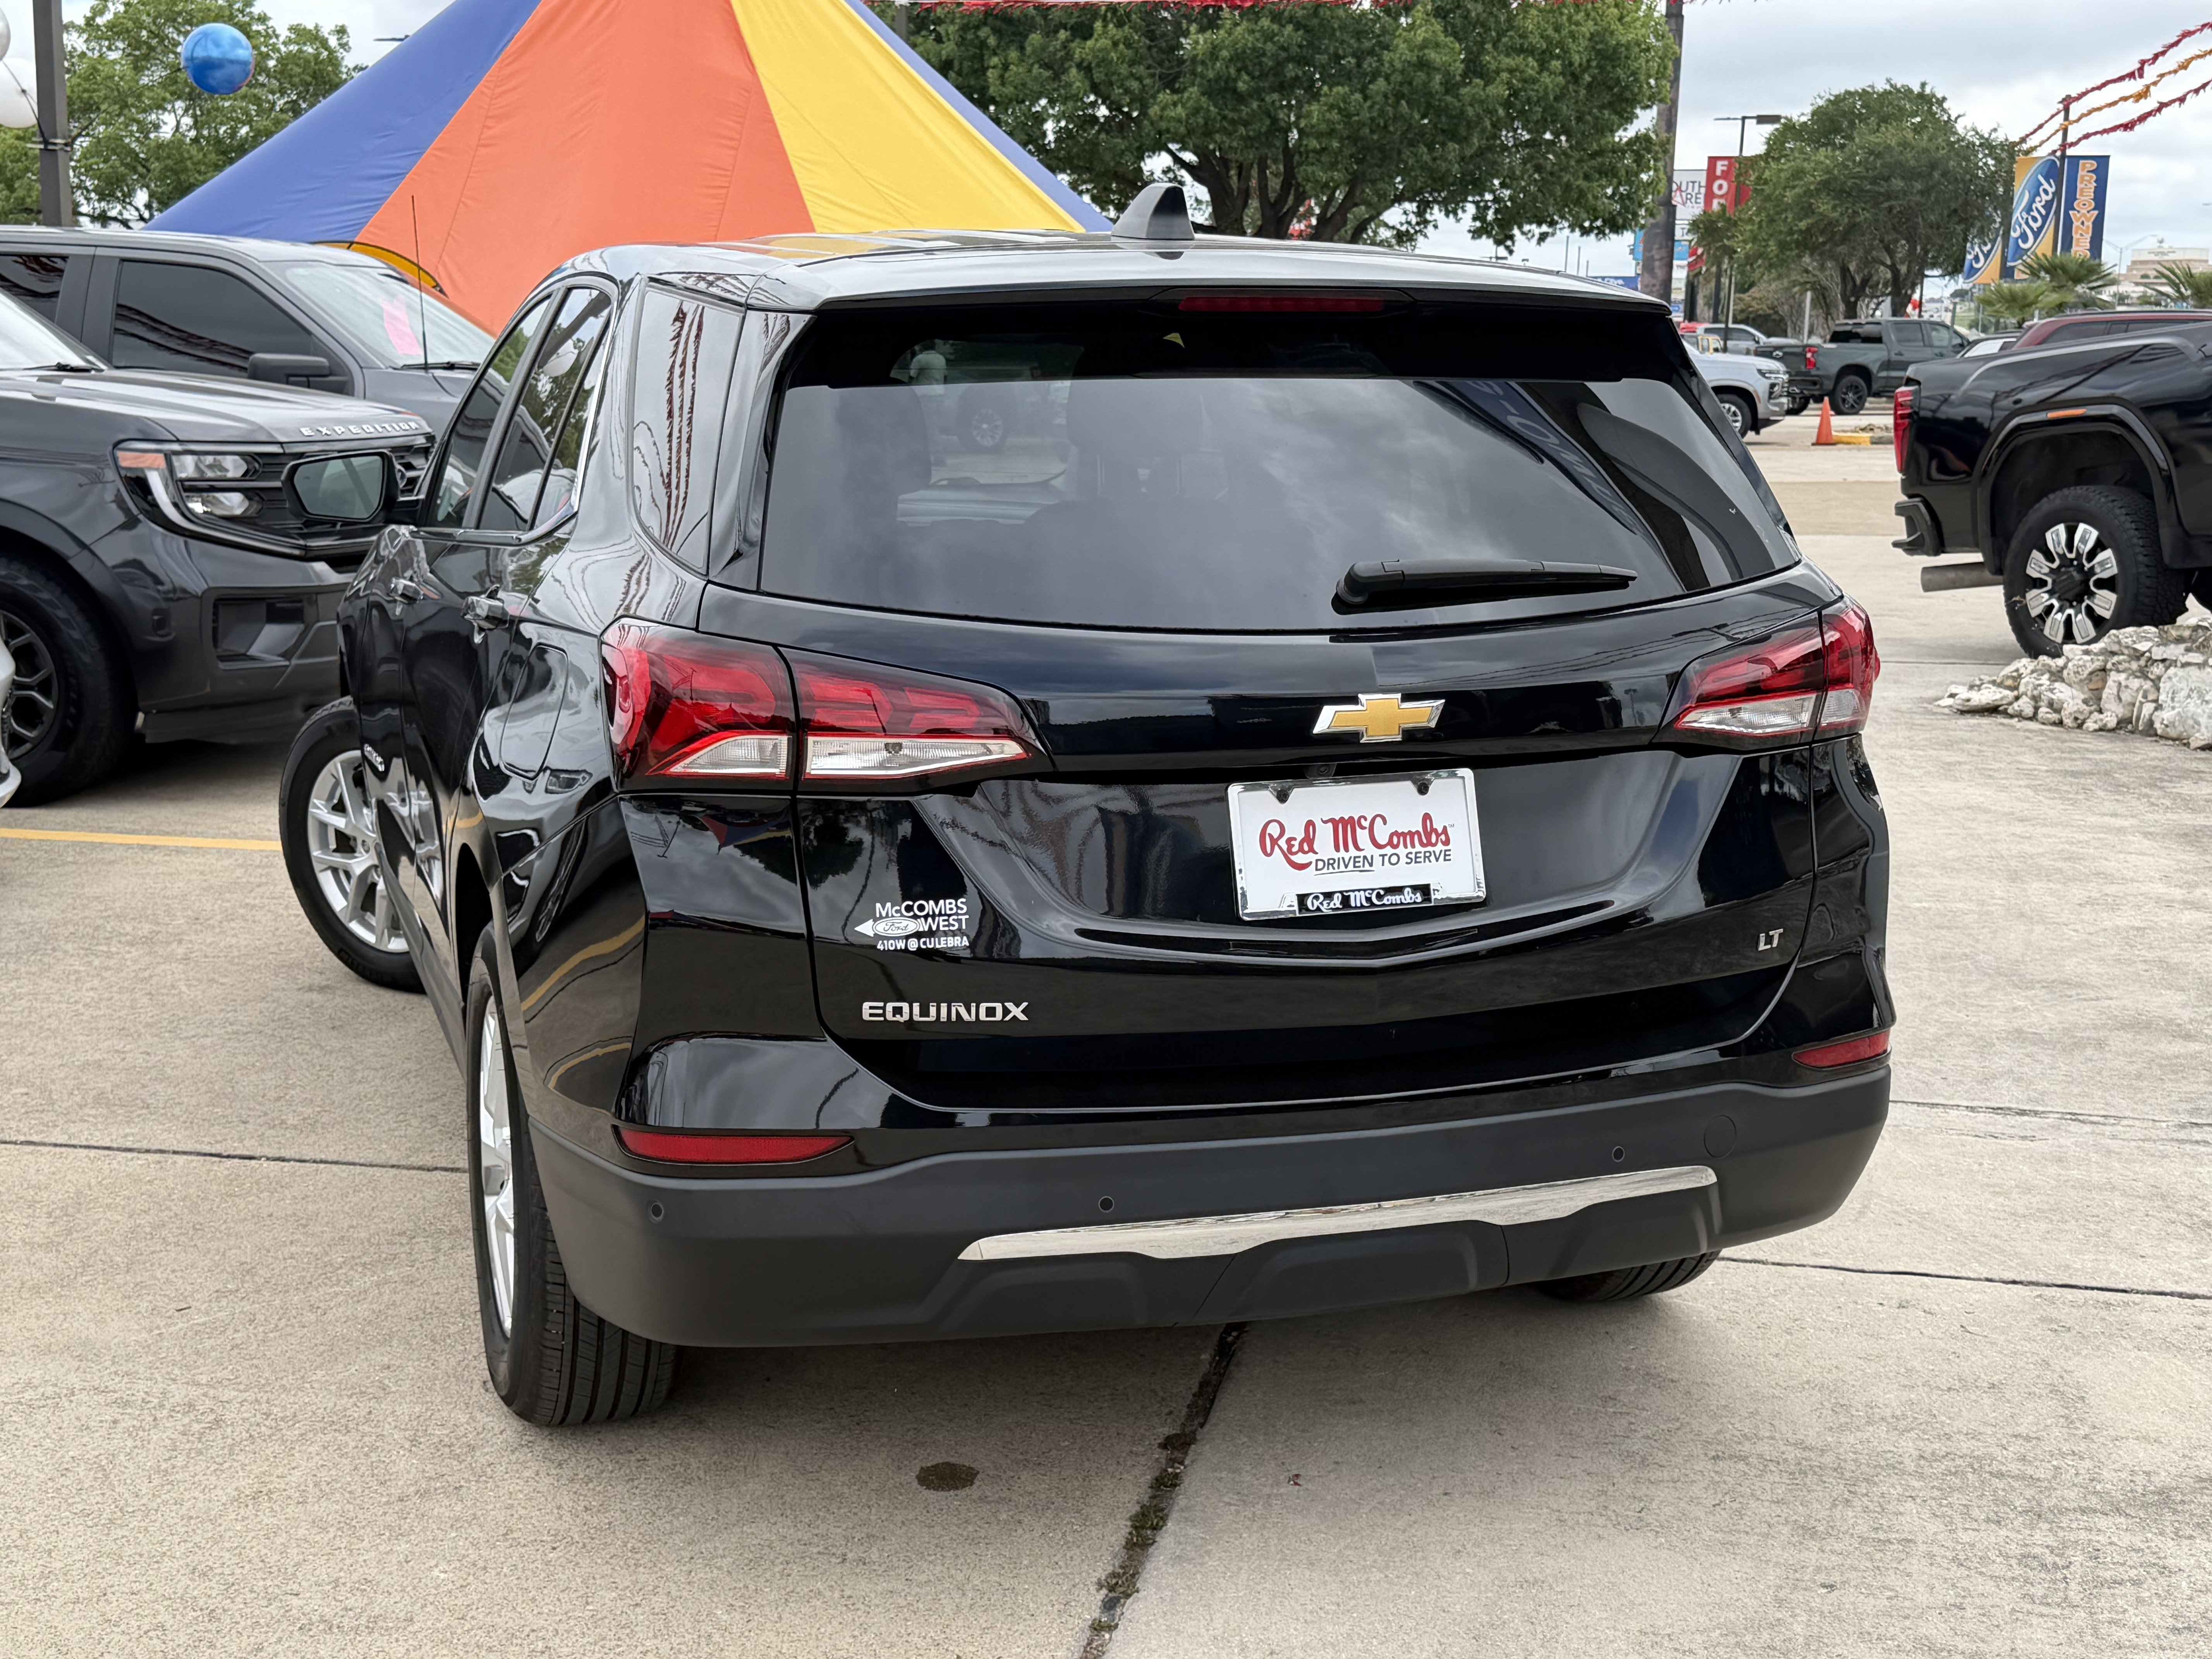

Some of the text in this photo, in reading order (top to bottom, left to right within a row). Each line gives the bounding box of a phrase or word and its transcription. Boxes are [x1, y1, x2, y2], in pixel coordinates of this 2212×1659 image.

[2011, 174, 2056, 249] Ford
[300, 421, 420, 436] EXPEDITION
[1259, 819, 1319, 871] Red
[1321, 812, 1450, 853] McCombs
[1314, 849, 1451, 871] DRIVEN TO SERVE
[876, 898, 967, 918] McCOMBS
[1307, 887, 1422, 913] Red McCombs
[883, 922, 909, 932] Ford
[921, 915, 969, 931] WEST
[877, 936, 970, 951] 410W @ CULEBRA
[1758, 928, 1784, 951] LT
[862, 1002, 1029, 1023] EQUINOX
